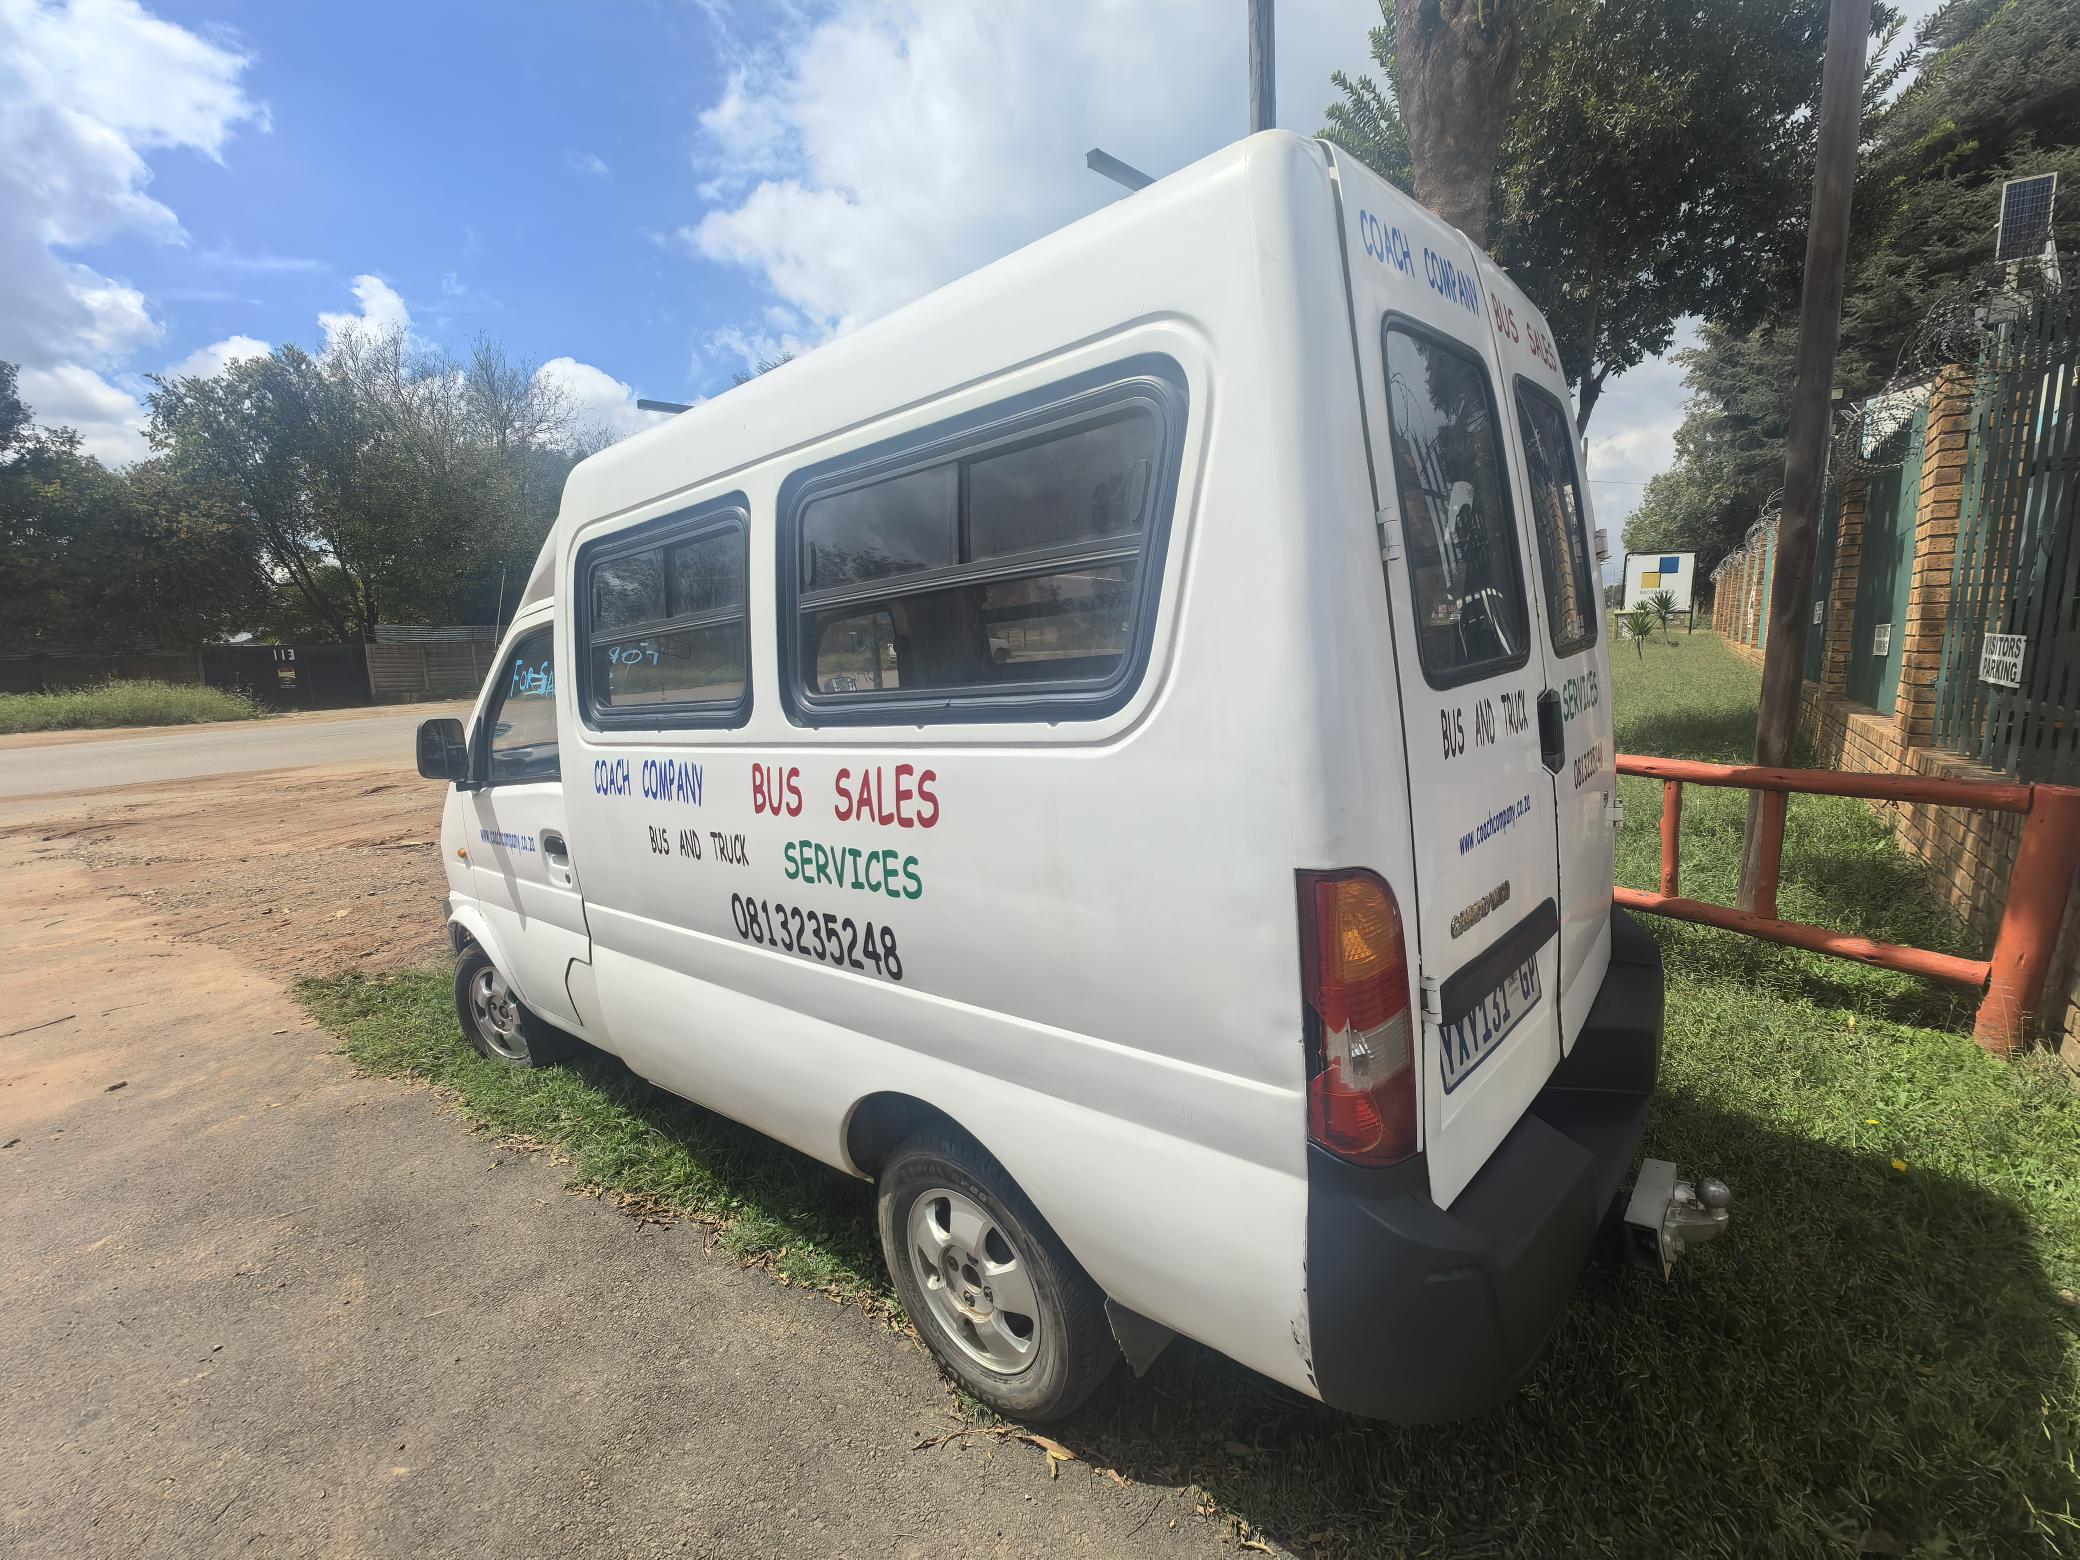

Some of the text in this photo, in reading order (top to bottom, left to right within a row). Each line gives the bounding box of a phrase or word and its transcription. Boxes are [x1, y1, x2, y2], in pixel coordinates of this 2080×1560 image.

[1360, 209, 1480, 318] COACH COMPANY
[1491, 292, 1557, 372] BUS SALES
[273, 649, 295, 660] 113
[1981, 659, 2018, 683] PARKING
[1984, 635, 2022, 659] VISITORS
[1562, 670, 1599, 722] SERVICES
[1440, 690, 1529, 760] BUS AND TRUCK
[594, 759, 703, 807] COACH COMPANY
[752, 762, 940, 829] BUS SALES
[649, 825, 750, 867] BUS AND TRUCK
[1459, 794, 1531, 857] www.coachcompany.co.za
[784, 839, 923, 900] SERVICES
[731, 893, 903, 981] 0813235248
[1520, 956, 1536, 1001] GP
